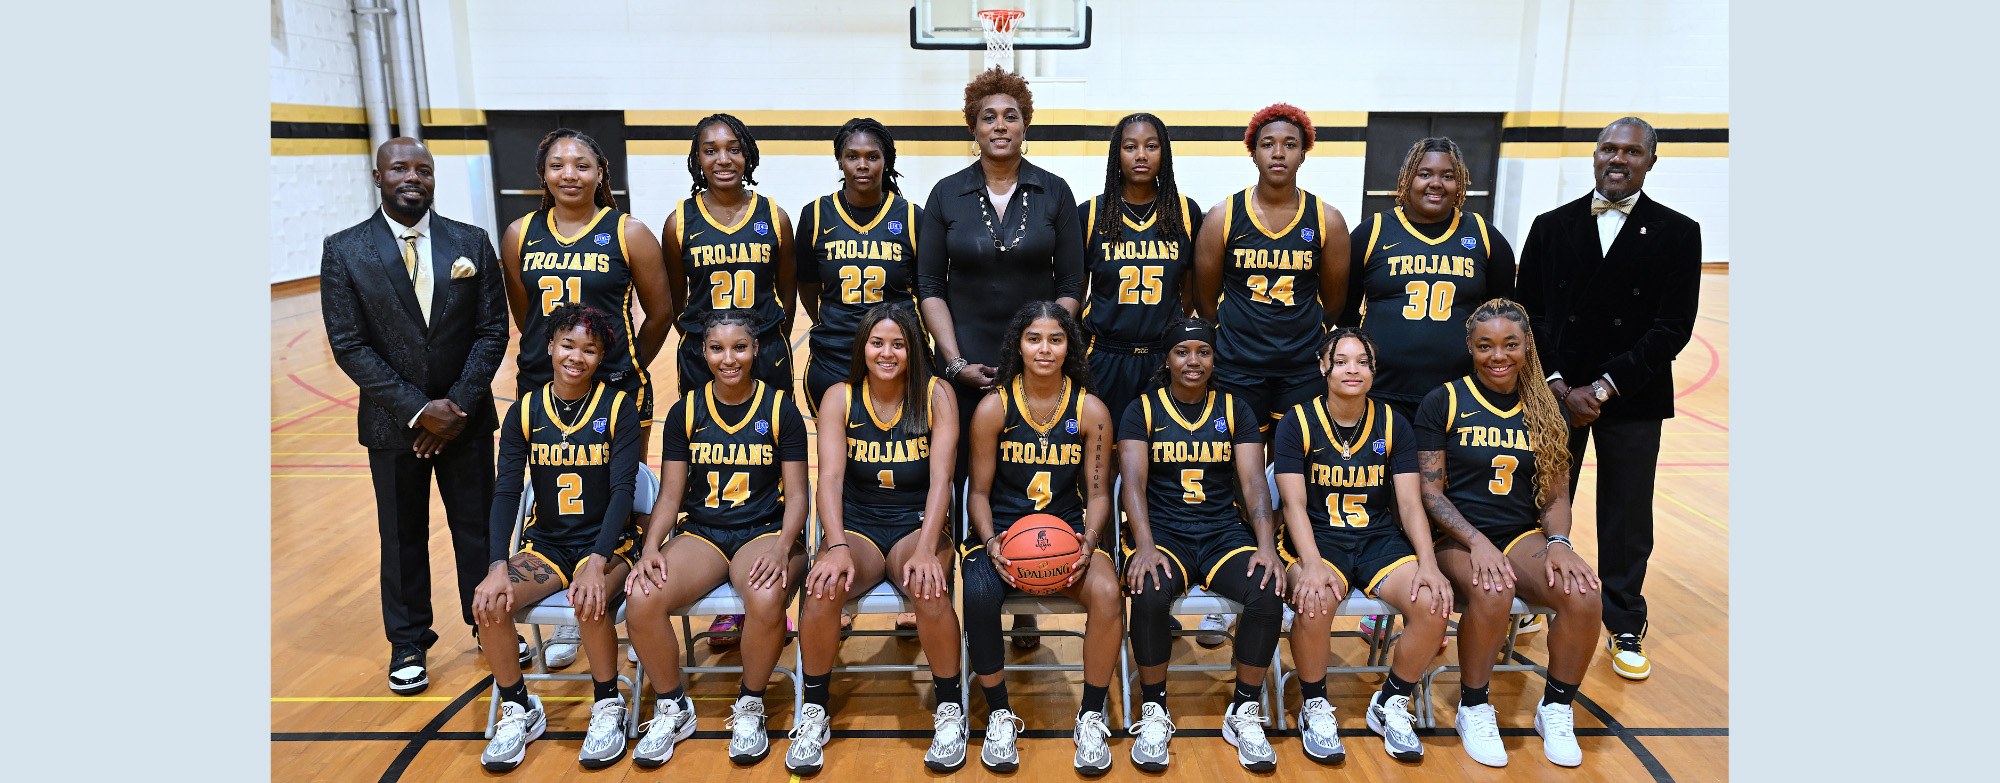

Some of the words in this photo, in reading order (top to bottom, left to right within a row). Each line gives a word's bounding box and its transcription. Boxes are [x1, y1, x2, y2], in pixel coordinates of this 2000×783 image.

[520, 251, 610, 274] TROJANS
[690, 242, 771, 267] TROJANS
[822, 239, 903, 262] TROJANS
[1101, 240, 1179, 261] TROJANS
[1233, 248, 1313, 271] TROJANS
[1387, 254, 1475, 279] TROJANS
[537, 275, 582, 317] 21
[709, 270, 756, 310] 20
[838, 264, 887, 305] 22
[1117, 265, 1165, 306] 25
[1246, 274, 1297, 307] 24
[1401, 280, 1457, 322] 30
[846, 436, 931, 463] TROJANS
[1152, 440, 1233, 464] TROJANS
[1456, 425, 1534, 452] TROJA
[688, 442, 773, 467] TROJANS
[1000, 440, 1082, 466] TROJANS
[876, 469, 896, 490] 1
[1179, 468, 1207, 505] 5
[1487, 454, 1520, 496] 3
[556, 472, 586, 517] 2
[703, 470, 752, 510] 14
[1026, 470, 1053, 513] 4
[1325, 492, 1370, 529] 15
[1017, 562, 1070, 580] SPALDING
